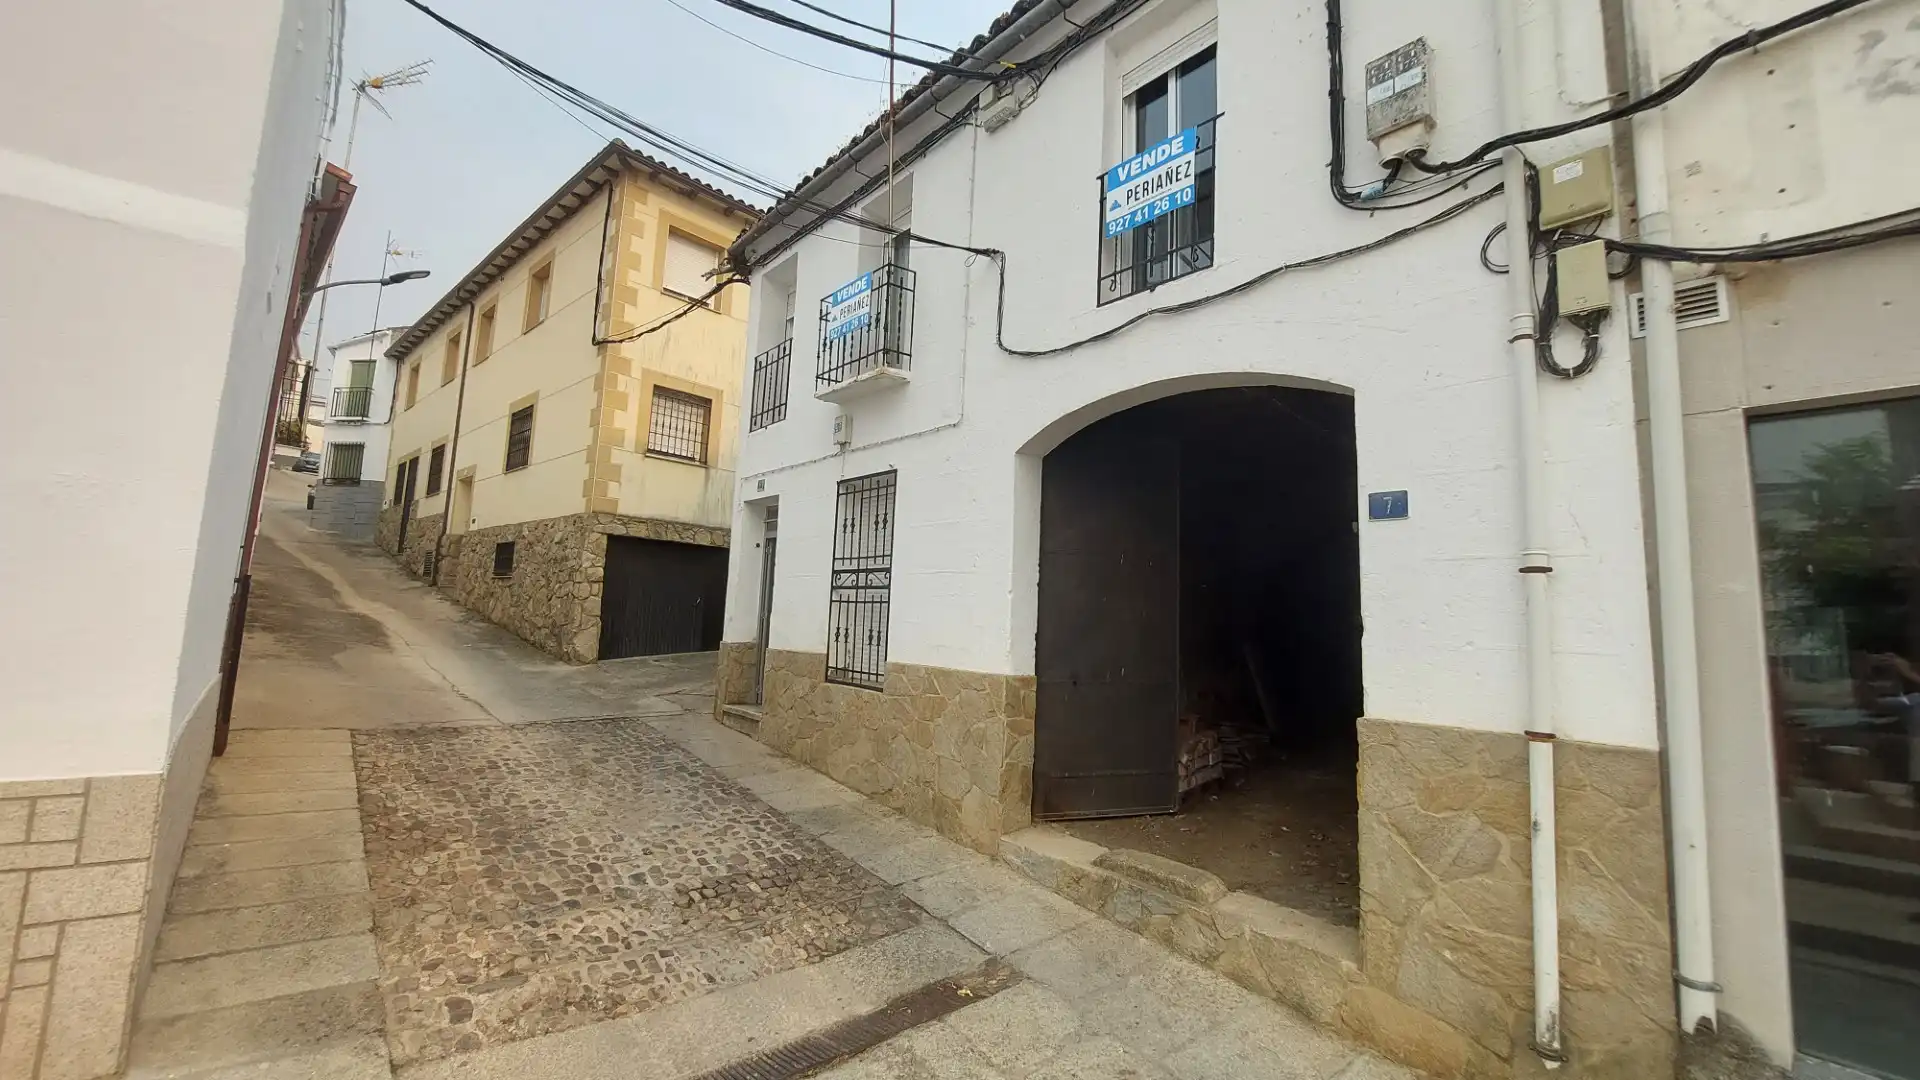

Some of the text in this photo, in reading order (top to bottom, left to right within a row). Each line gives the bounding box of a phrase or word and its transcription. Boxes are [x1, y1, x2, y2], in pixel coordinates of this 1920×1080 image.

[1117, 136, 1184, 182] VENDE
[1126, 160, 1192, 206] PERIAÑEZ
[1109, 214, 1131, 235] 927
[1134, 206, 1149, 223] 41
[1154, 197, 1170, 214] 26
[1175, 188, 1191, 205] 10
[836, 276, 868, 302] VENDE
[830, 327, 842, 340] 927
[851, 319, 859, 329] 26
[861, 314, 869, 324] 10
[1383, 496, 1392, 515] 7
